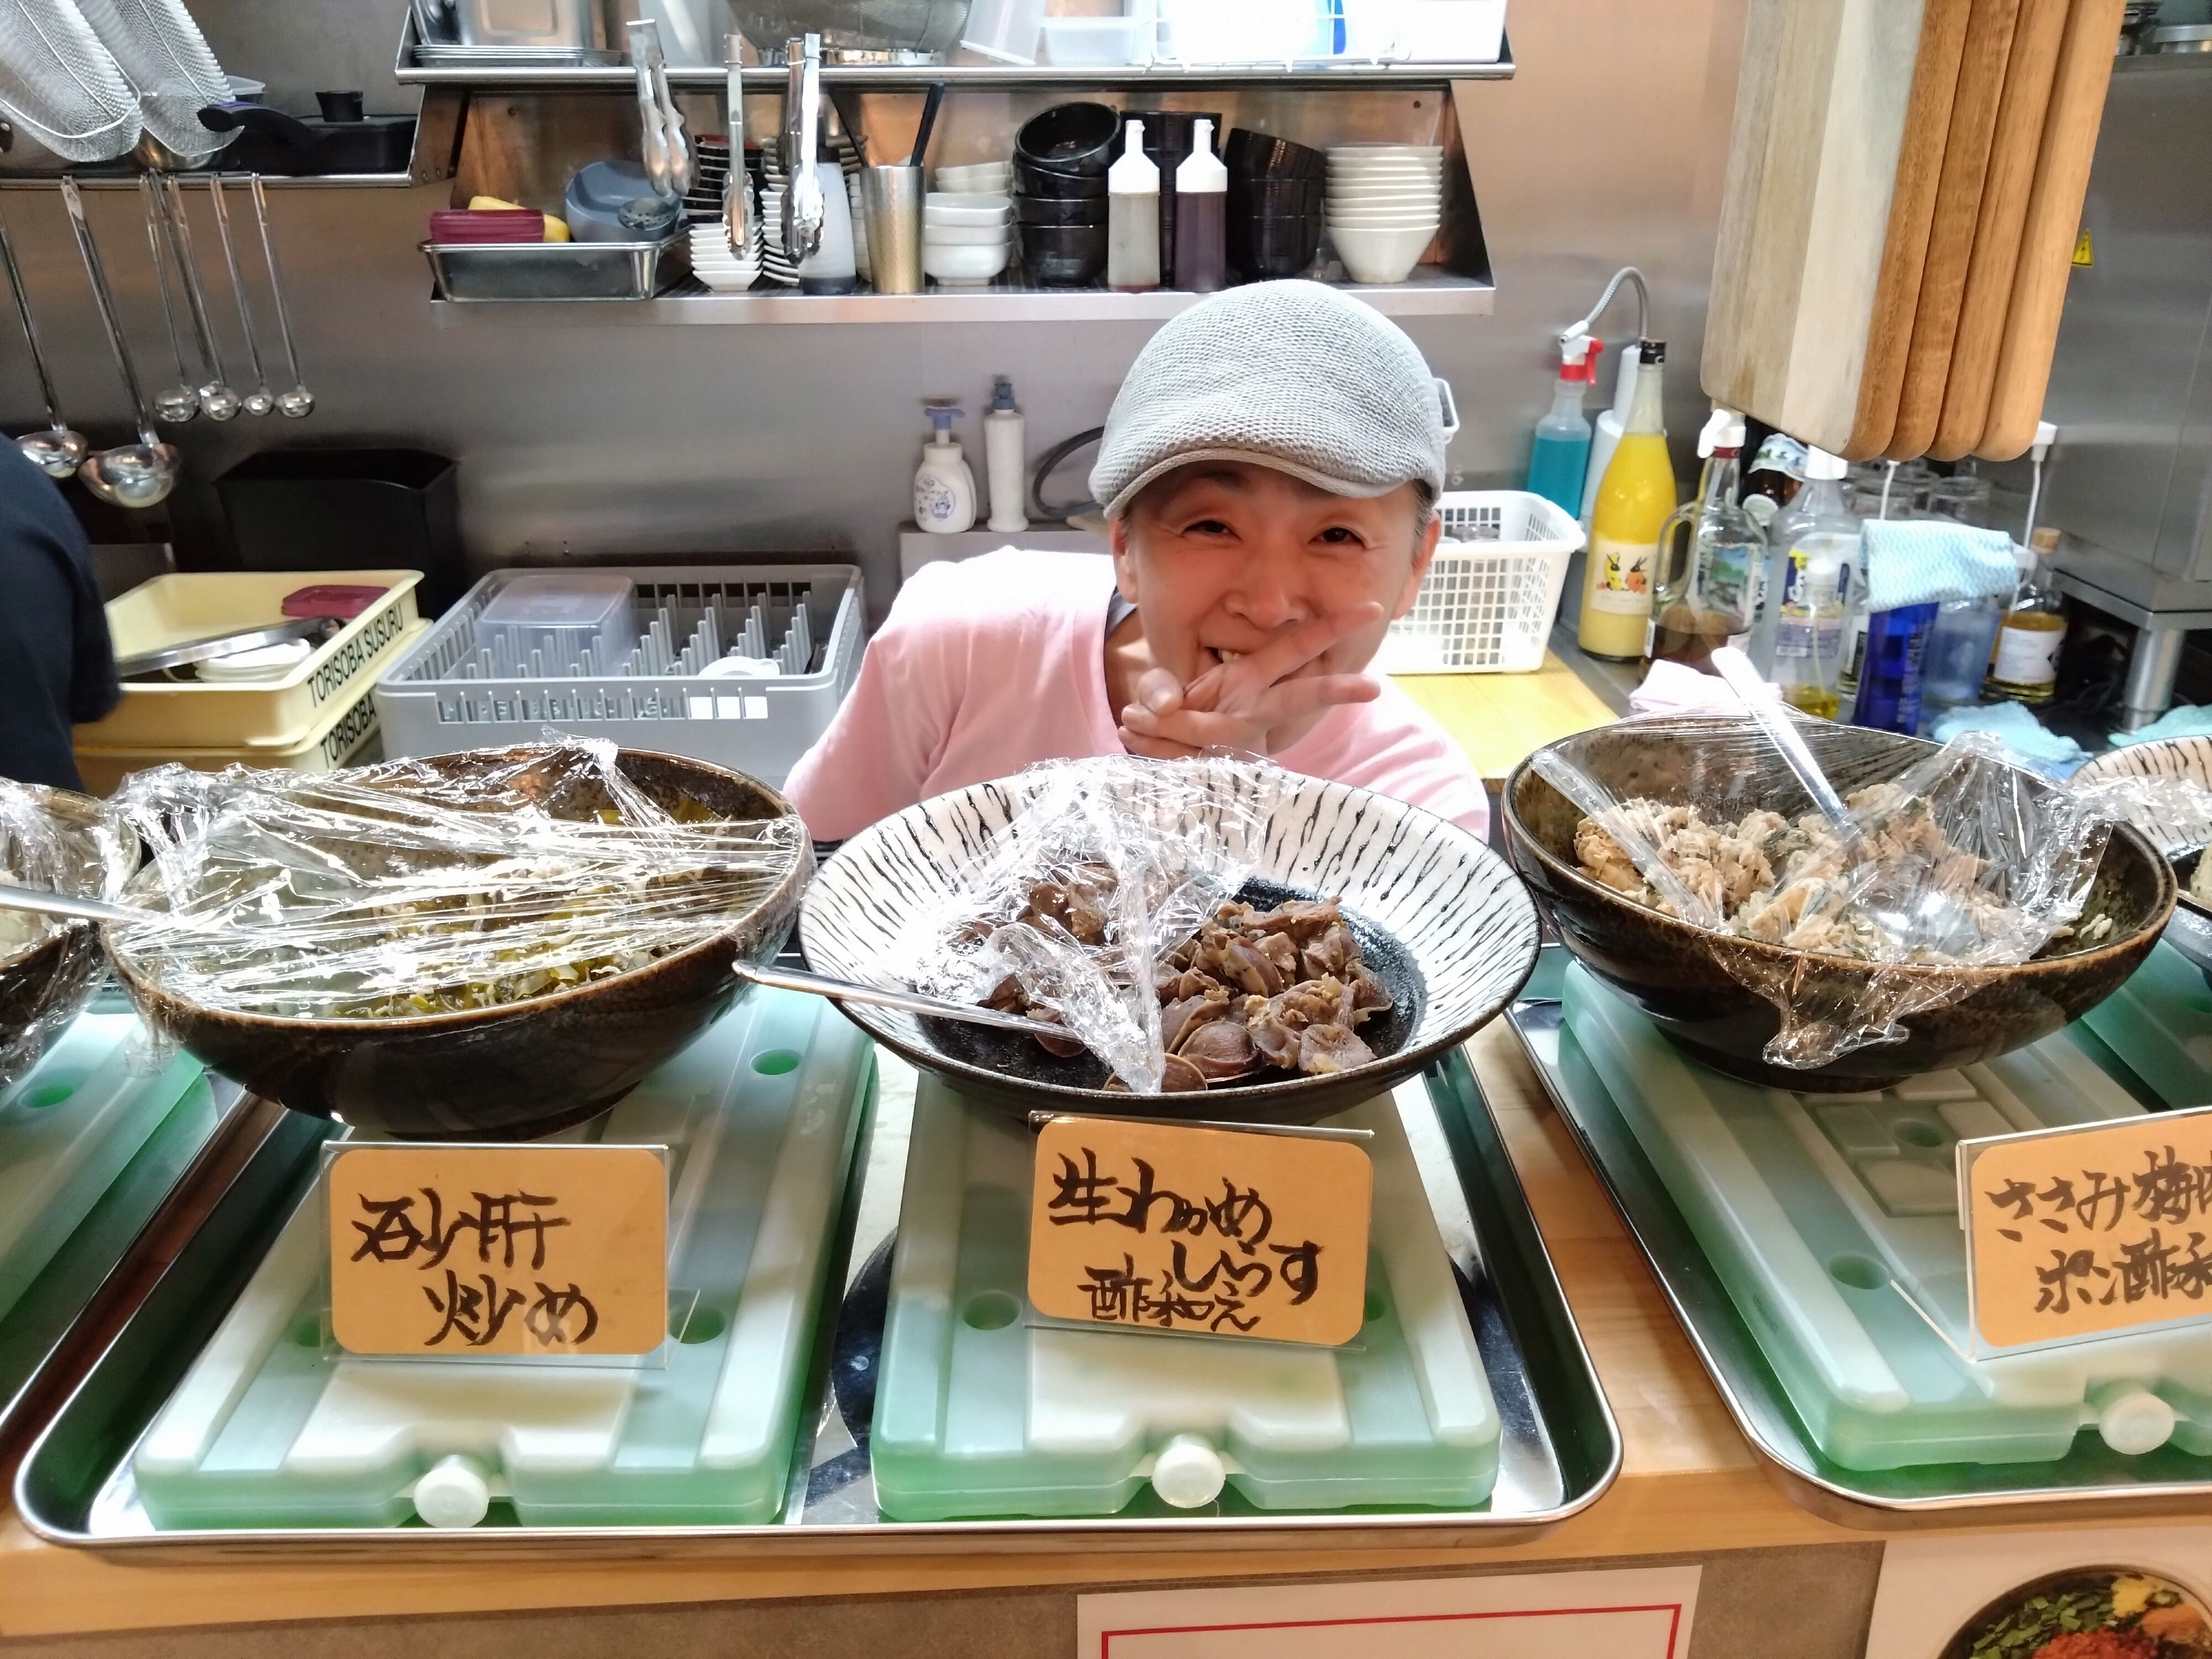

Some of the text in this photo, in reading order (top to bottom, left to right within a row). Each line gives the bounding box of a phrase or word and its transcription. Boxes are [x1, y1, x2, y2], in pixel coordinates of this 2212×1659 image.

[307, 602, 404, 708] TORISOBA SUSURU
[320, 693, 377, 769] TORISOBA
[351, 1187, 572, 1270] 砂肝
[1048, 1146, 1272, 1245] 生わかめ
[422, 1269, 598, 1347] 炒め
[1077, 1251, 1260, 1332] 酢和え
[1171, 1239, 1324, 1306] しらす
